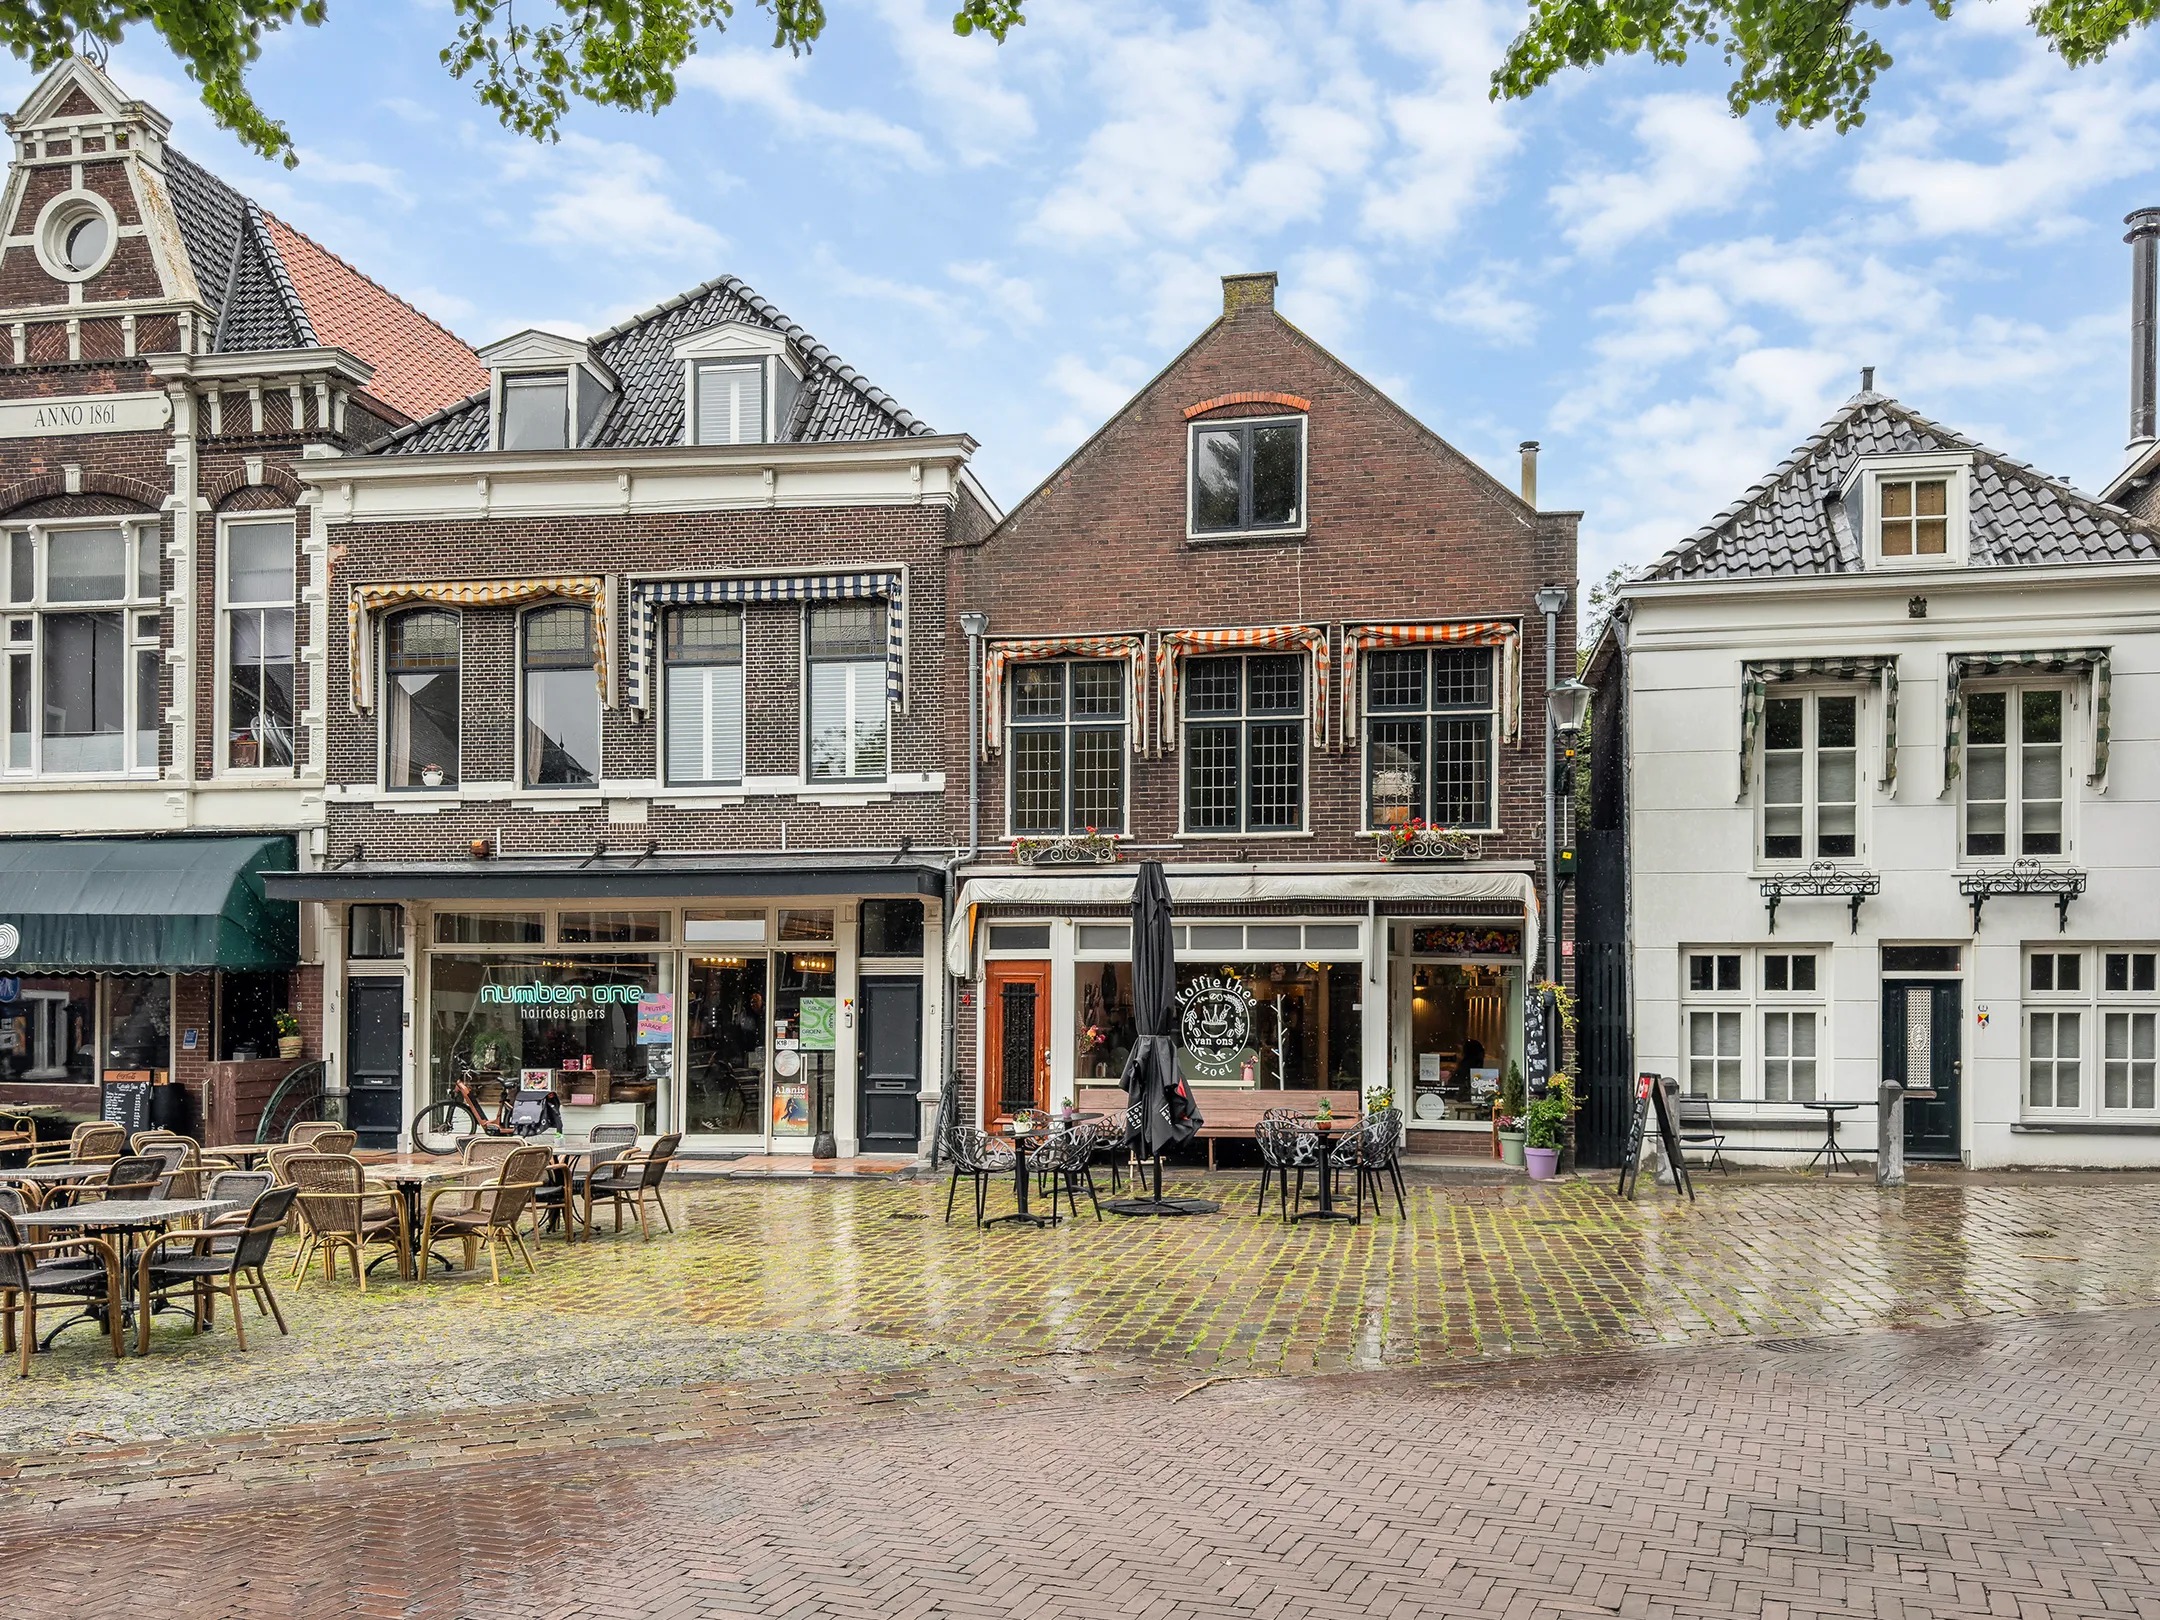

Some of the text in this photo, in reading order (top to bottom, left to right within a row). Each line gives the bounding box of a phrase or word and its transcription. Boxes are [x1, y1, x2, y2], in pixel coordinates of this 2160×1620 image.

[34, 404, 116, 428] ANNO 1861
[481, 980, 644, 1004] number one
[1175, 975, 1258, 1007] Koffie thee
[962, 993, 971, 1006] 4
[520, 1005, 606, 1022] hairdesigners
[645, 1004, 666, 1012] PEUTER
[1194, 1037, 1234, 1046] van ons
[775, 1086, 806, 1094] Alanis
